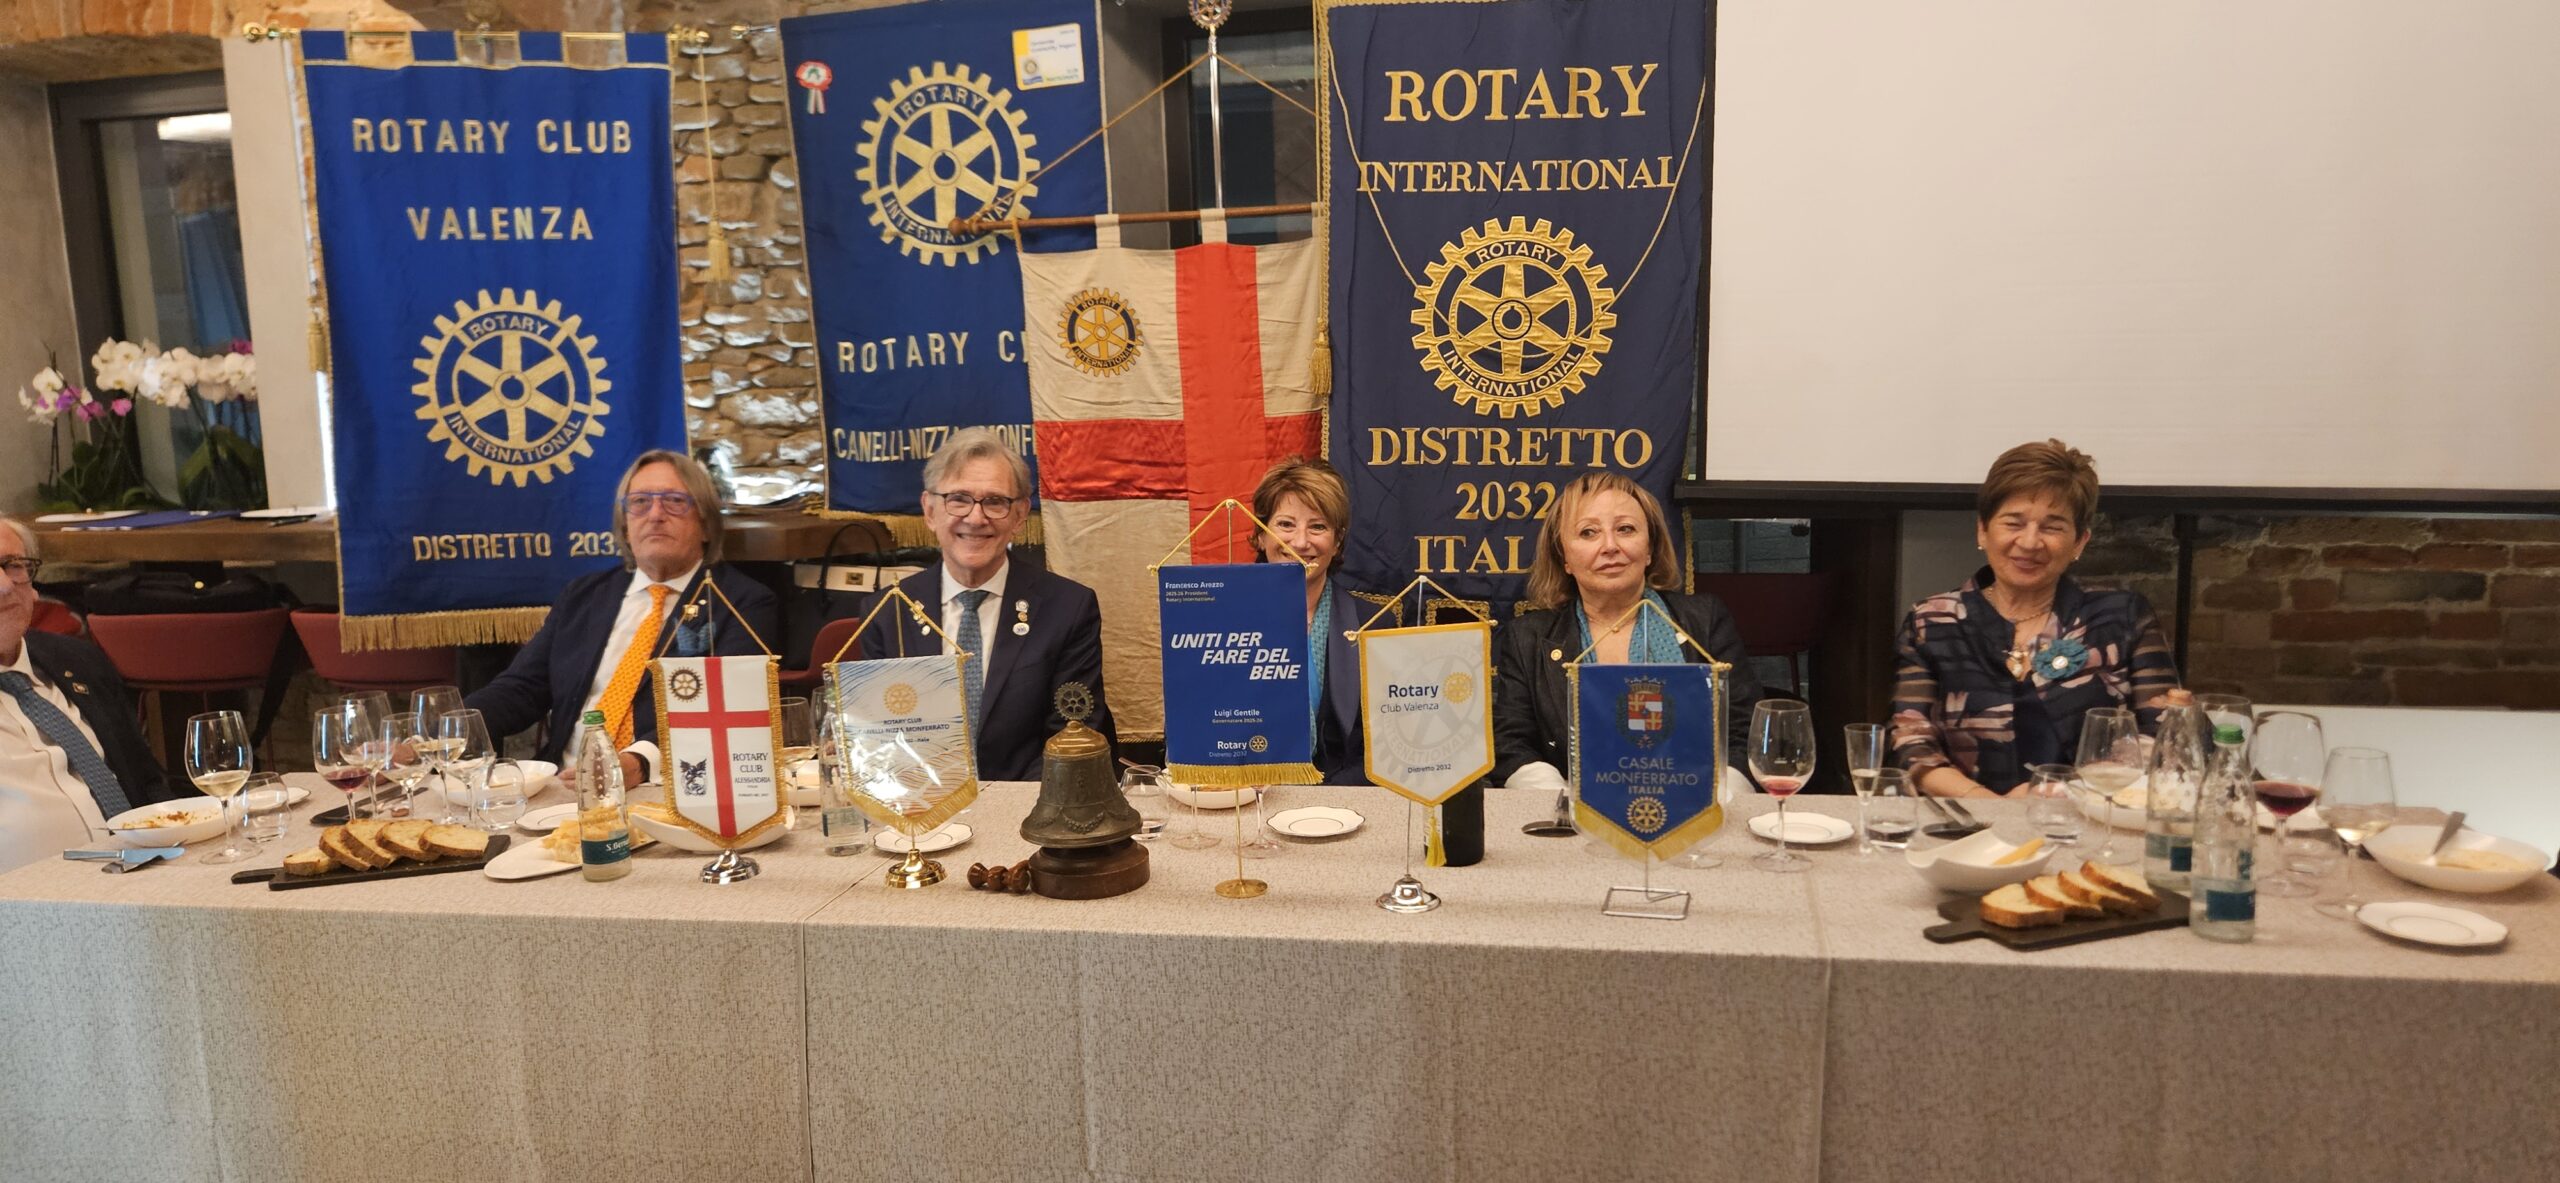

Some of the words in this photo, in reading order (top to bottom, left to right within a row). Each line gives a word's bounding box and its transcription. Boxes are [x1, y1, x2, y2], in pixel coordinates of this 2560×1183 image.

[901, 85, 984, 118] ROTARY
[1384, 63, 1659, 122] ROTARY
[352, 118, 510, 153] ROTARY
[537, 118, 632, 154] CLUB
[1356, 156, 1677, 193] INTERNATIONAL
[407, 207, 593, 241] VALENZA
[1475, 242, 1557, 264] ROTARY
[468, 315, 548, 338] ROTARY
[837, 331, 969, 373] ROTARY
[1442, 347, 1582, 397] INTERNATIONAL
[448, 414, 583, 464] INTERNATIONAL
[832, 425, 959, 462] CANELLI-NIZZ
[1367, 427, 1653, 468] DISTRETTO
[1455, 481, 1556, 520] 2032
[413, 533, 551, 561] DISTRETTO
[1414, 535, 1532, 573] ITAL
[1171, 633, 1222, 649] UNITI
[1226, 632, 1262, 647] PER
[1201, 649, 1251, 664] FARE
[1254, 648, 1290, 663] DEL
[1249, 664, 1301, 680] BENE
[1388, 683, 1439, 698] Rotary
[1214, 709, 1232, 717] Luigi
[1380, 703, 1402, 713] Club
[1405, 701, 1439, 711] Valenza
[905, 723, 950, 732] MONFERRATO
[1217, 741, 1247, 750] Rotary
[732, 753, 768, 761] ROTARY
[1618, 756, 1675, 770] CASALE
[739, 764, 763, 773] CLUB
[1595, 771, 1698, 785] MONFERRATO
[1628, 786, 1665, 794] ITALIA
